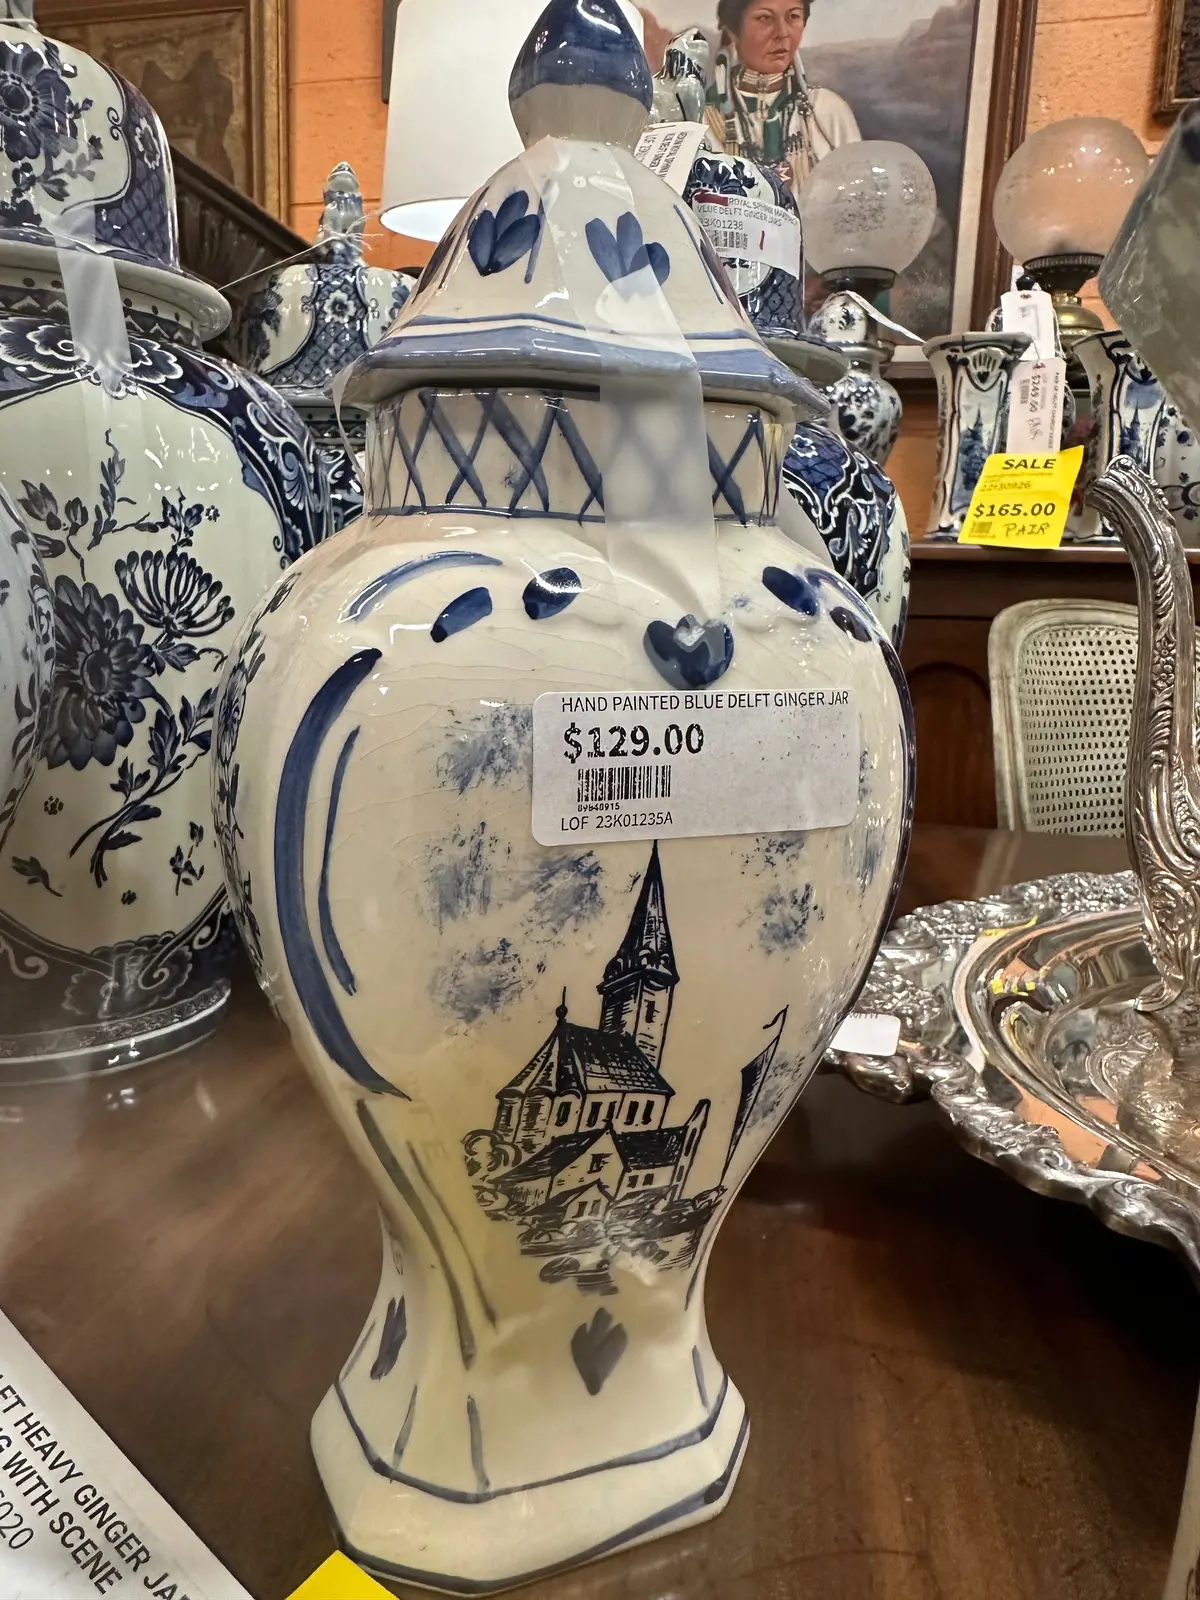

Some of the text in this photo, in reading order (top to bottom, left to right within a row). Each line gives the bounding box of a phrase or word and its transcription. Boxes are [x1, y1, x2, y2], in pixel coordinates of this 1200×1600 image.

[729, 197, 752, 208] ROYAL
[1002, 458, 1056, 470] SALE
[973, 503, 1056, 518] $165.00
[562, 690, 849, 712] HAND PAINTED BLUE DELFT GINGER JAR
[563, 722, 704, 764] $129.00
[561, 811, 673, 831] LOF 23K01235A
[14, 1412, 84, 1484] HEAVY
[73, 1484, 151, 1573] GINGER
[2, 1450, 61, 1517] WITH
[49, 1511, 123, 1596] SCENE
